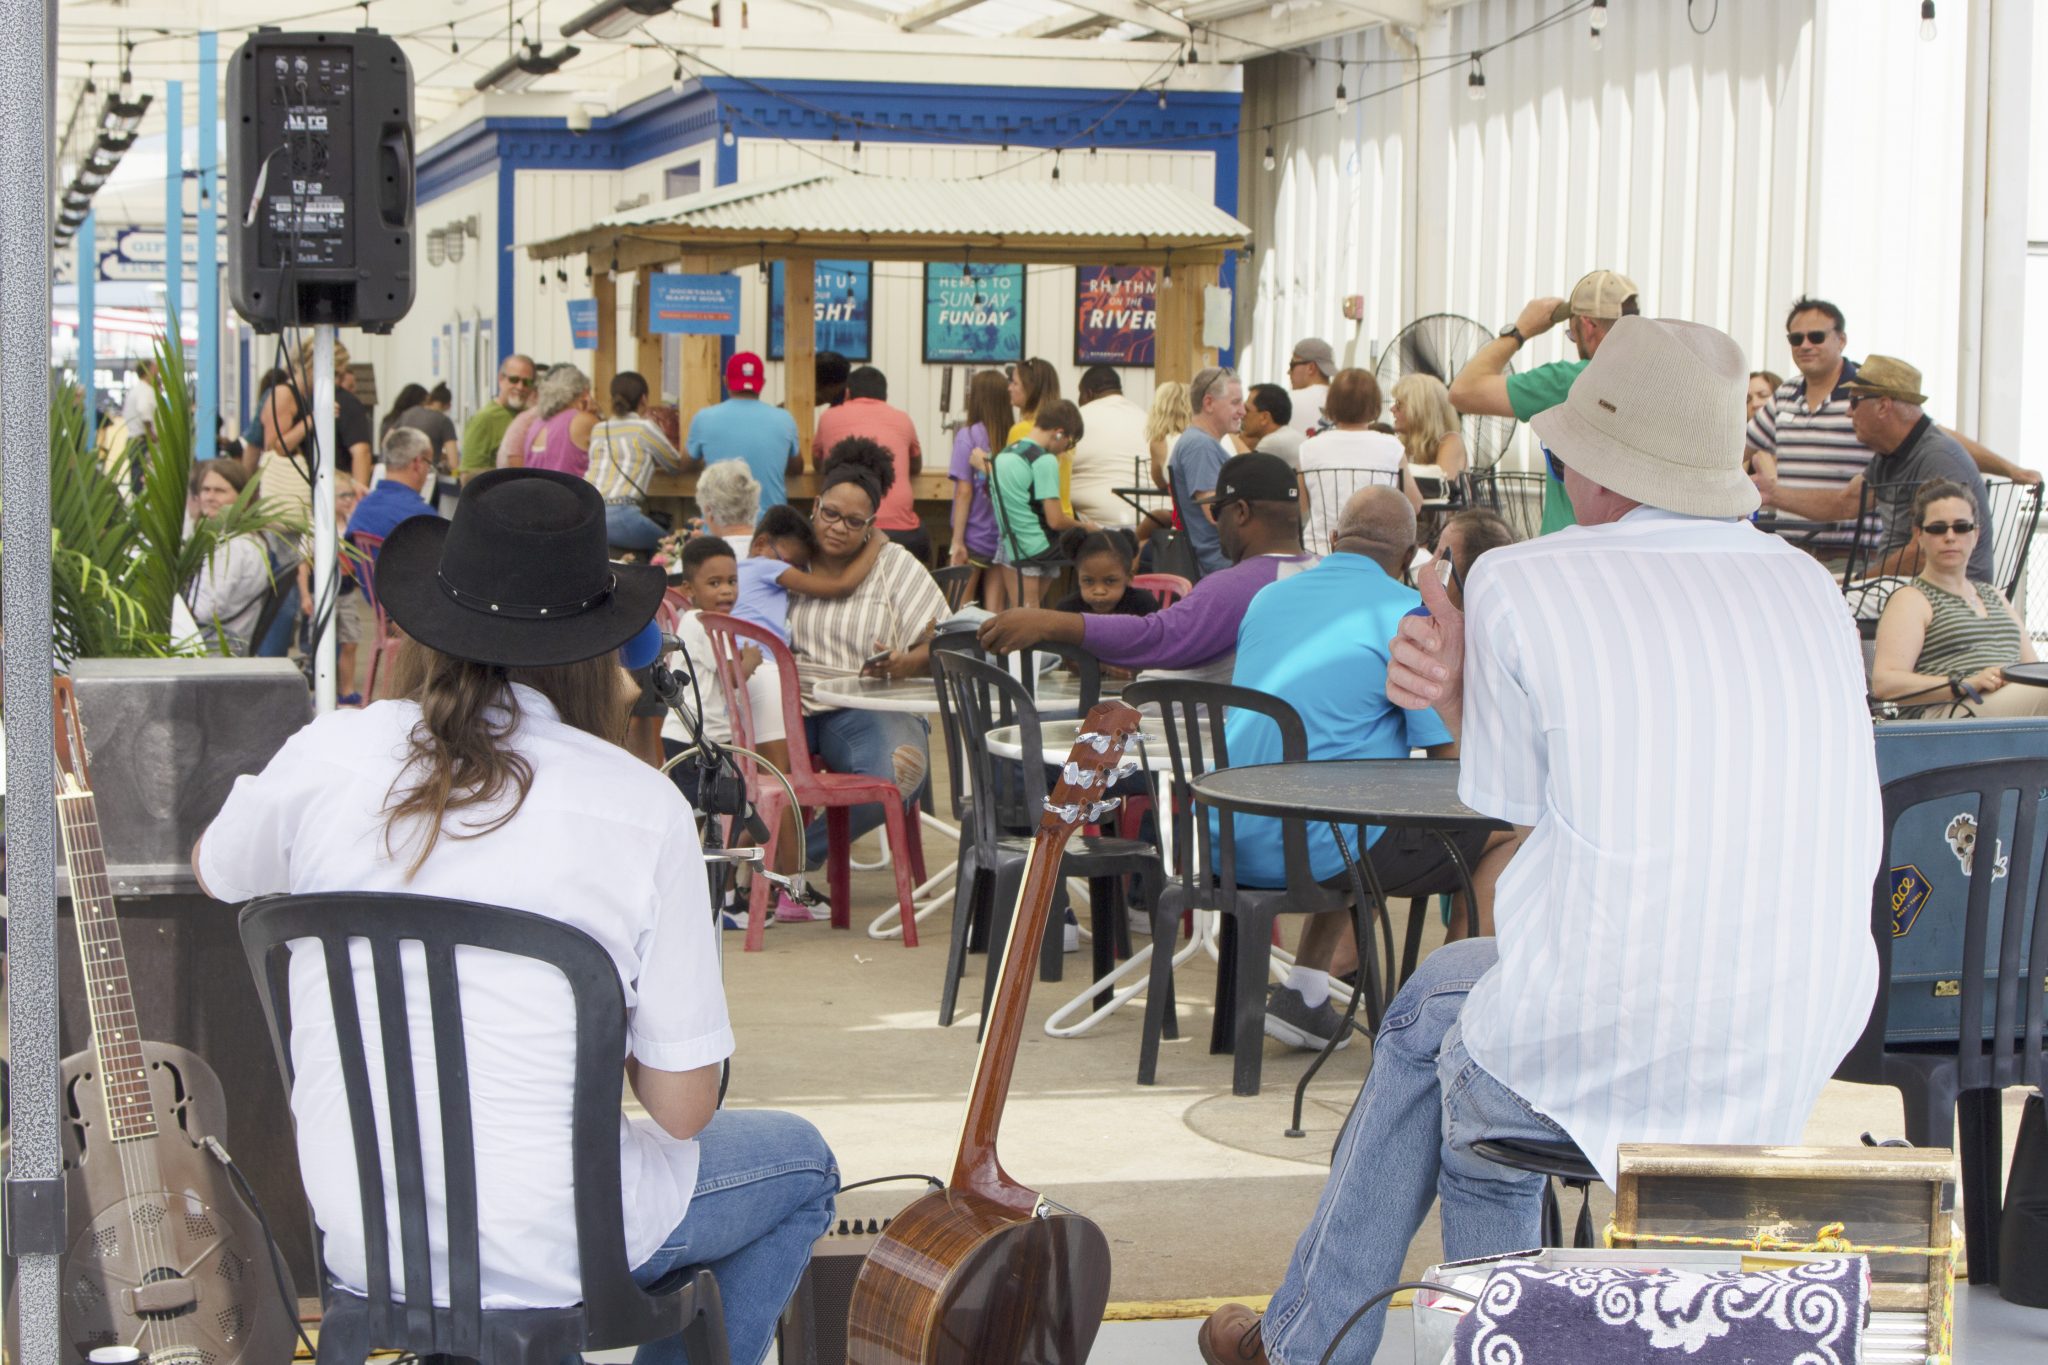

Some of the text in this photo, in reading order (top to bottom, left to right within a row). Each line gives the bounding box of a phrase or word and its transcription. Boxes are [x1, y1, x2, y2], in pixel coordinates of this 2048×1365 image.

[939, 276, 1012, 290] HERES TO
[939, 290, 1011, 308] SUNDAY
[1109, 297, 1144, 307] ON THE
[814, 302, 856, 322] GHT
[938, 310, 1010, 326] FUNDAY
[1089, 308, 1156, 330] RIVER
[1892, 878, 1915, 911] ace
